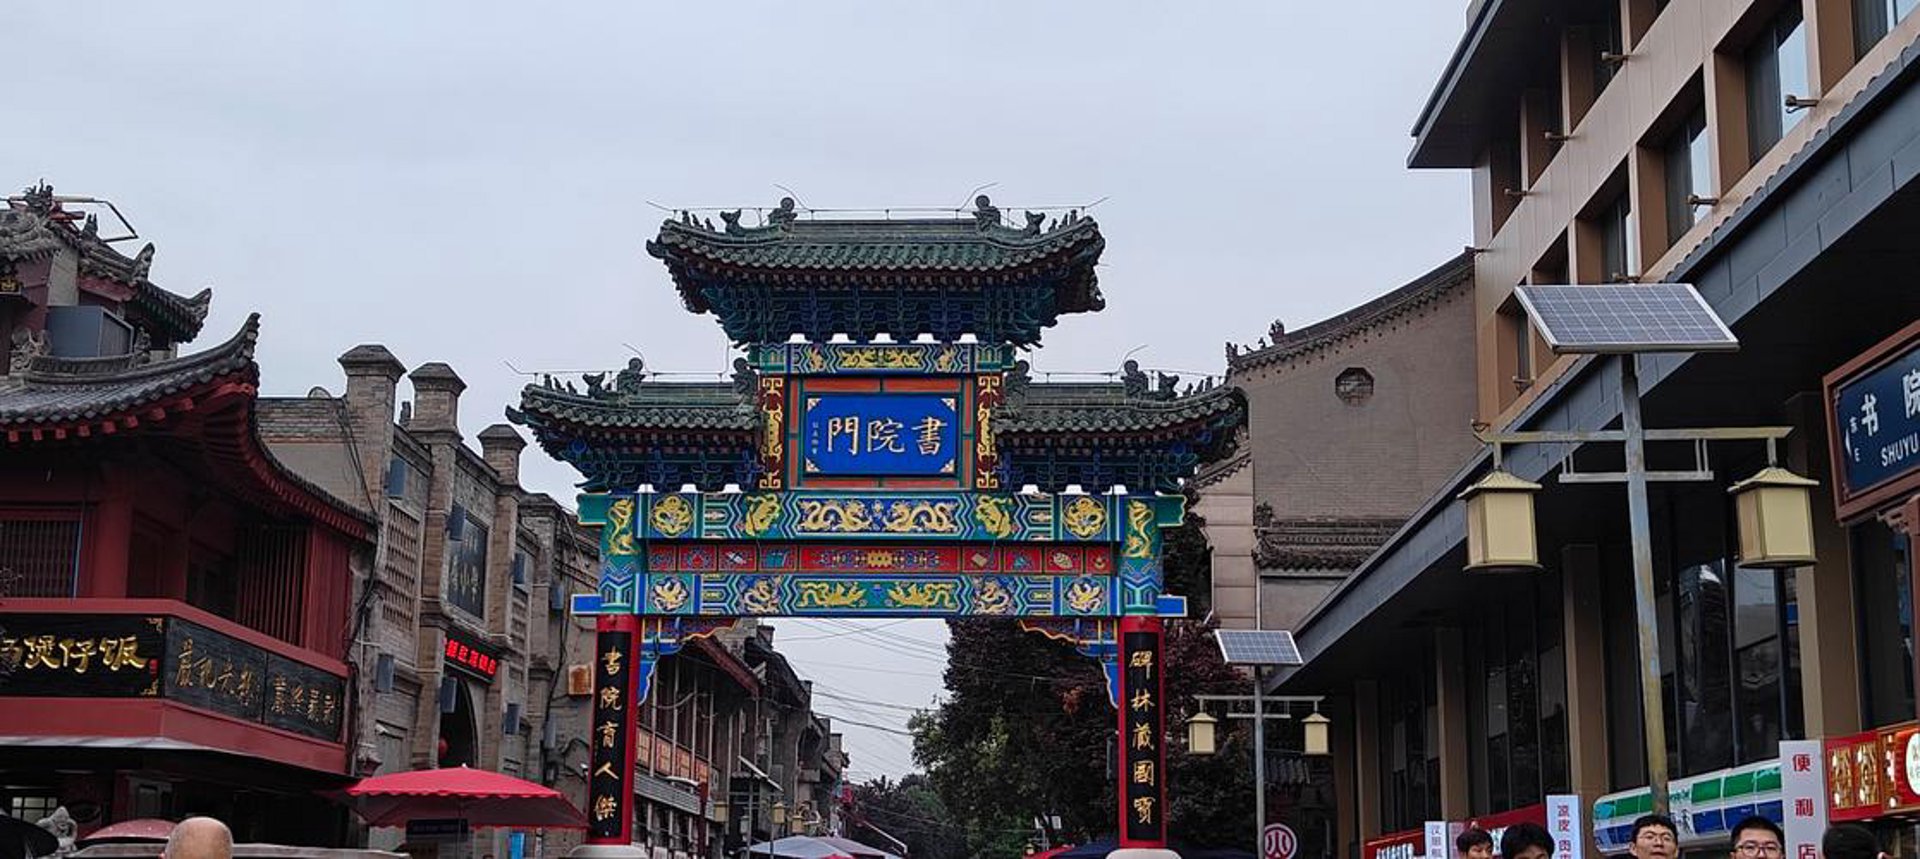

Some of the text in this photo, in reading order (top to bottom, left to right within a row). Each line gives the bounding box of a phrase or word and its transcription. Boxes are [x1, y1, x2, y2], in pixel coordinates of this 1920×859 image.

[1853, 447, 1861, 462] E
[1792, 753, 1817, 859] 便利店
